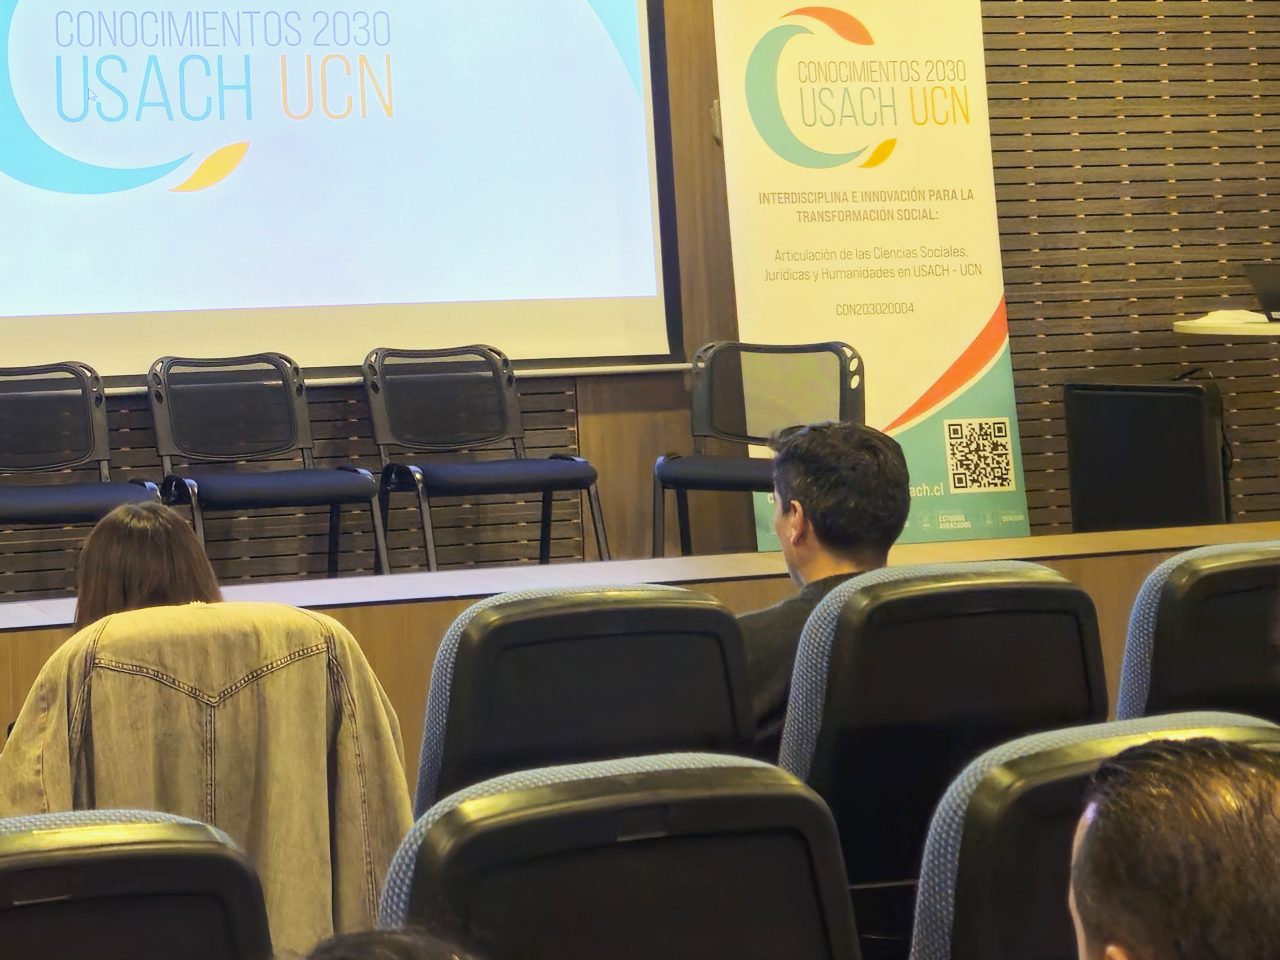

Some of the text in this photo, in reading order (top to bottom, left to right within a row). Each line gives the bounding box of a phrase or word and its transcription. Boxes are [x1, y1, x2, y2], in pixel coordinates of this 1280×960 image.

[55, 10, 392, 48] CONOCIMIENTOS 2030
[798, 59, 967, 83] CONOCIMIENTOS 2030
[55, 53, 394, 123] USACH UCN
[799, 85, 970, 127] USACH UCN
[759, 187, 975, 205] INTERDISCIPLINA E INNOVACIÓN PARA LA
[796, 207, 940, 223] TRANSFORMACIÓN SOCIAL:
[774, 248, 837, 262] Articulación
[840, 248, 853, 260] de
[855, 248, 871, 260] las
[873, 246, 918, 259] Ciencias
[812, 270, 819, 282] y
[821, 267, 895, 280] Humanidades
[897, 268, 911, 278] en
[913, 264, 950, 277] USACH
[960, 263, 983, 276] UCN
